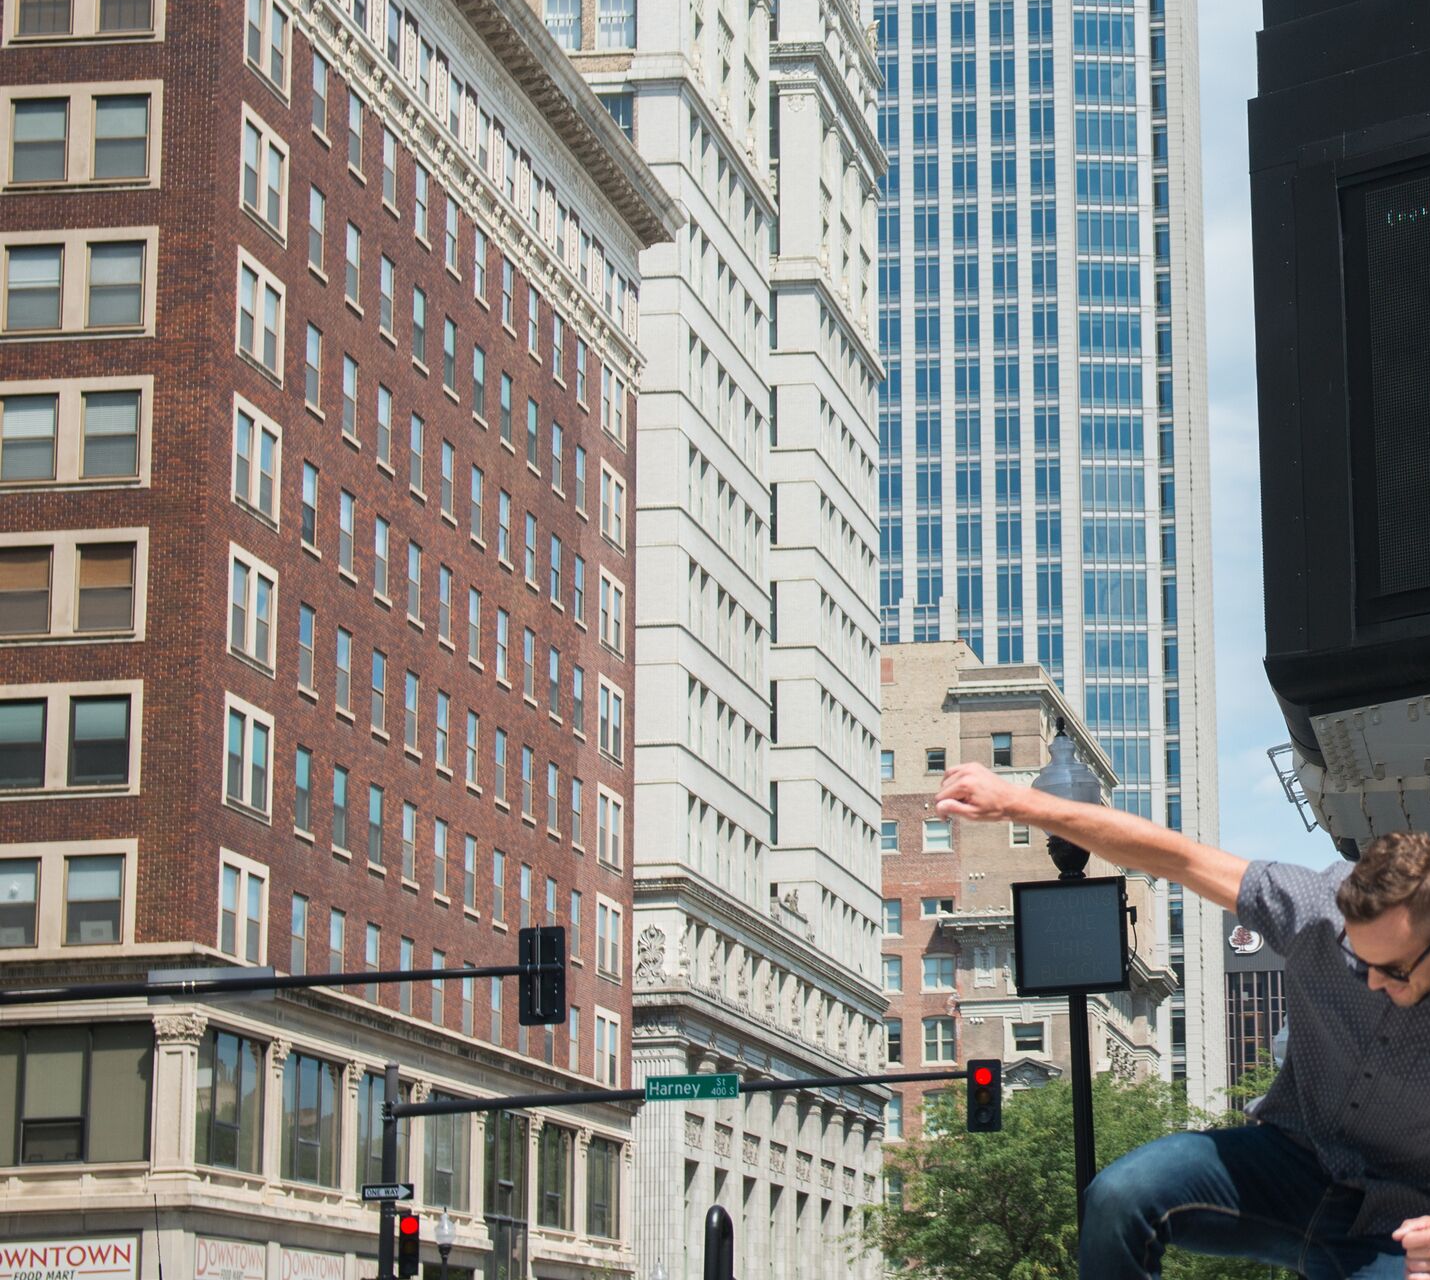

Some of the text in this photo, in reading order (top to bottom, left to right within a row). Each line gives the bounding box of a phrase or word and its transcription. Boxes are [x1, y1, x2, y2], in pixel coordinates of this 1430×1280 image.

[1027, 891, 1112, 911] LOADING
[1045, 913, 1097, 933] ZONE
[1049, 939, 1094, 958] THIS
[1040, 960, 1104, 981] BLOCK
[649, 1077, 726, 1098] Harney St
[711, 1086, 735, 1096] 400 S
[384, 1188, 399, 1197] WAY
[0, 1243, 131, 1269] WNTOWN
[196, 1238, 264, 1276] DOWNTOWN
[45, 1269, 76, 1280] MART
